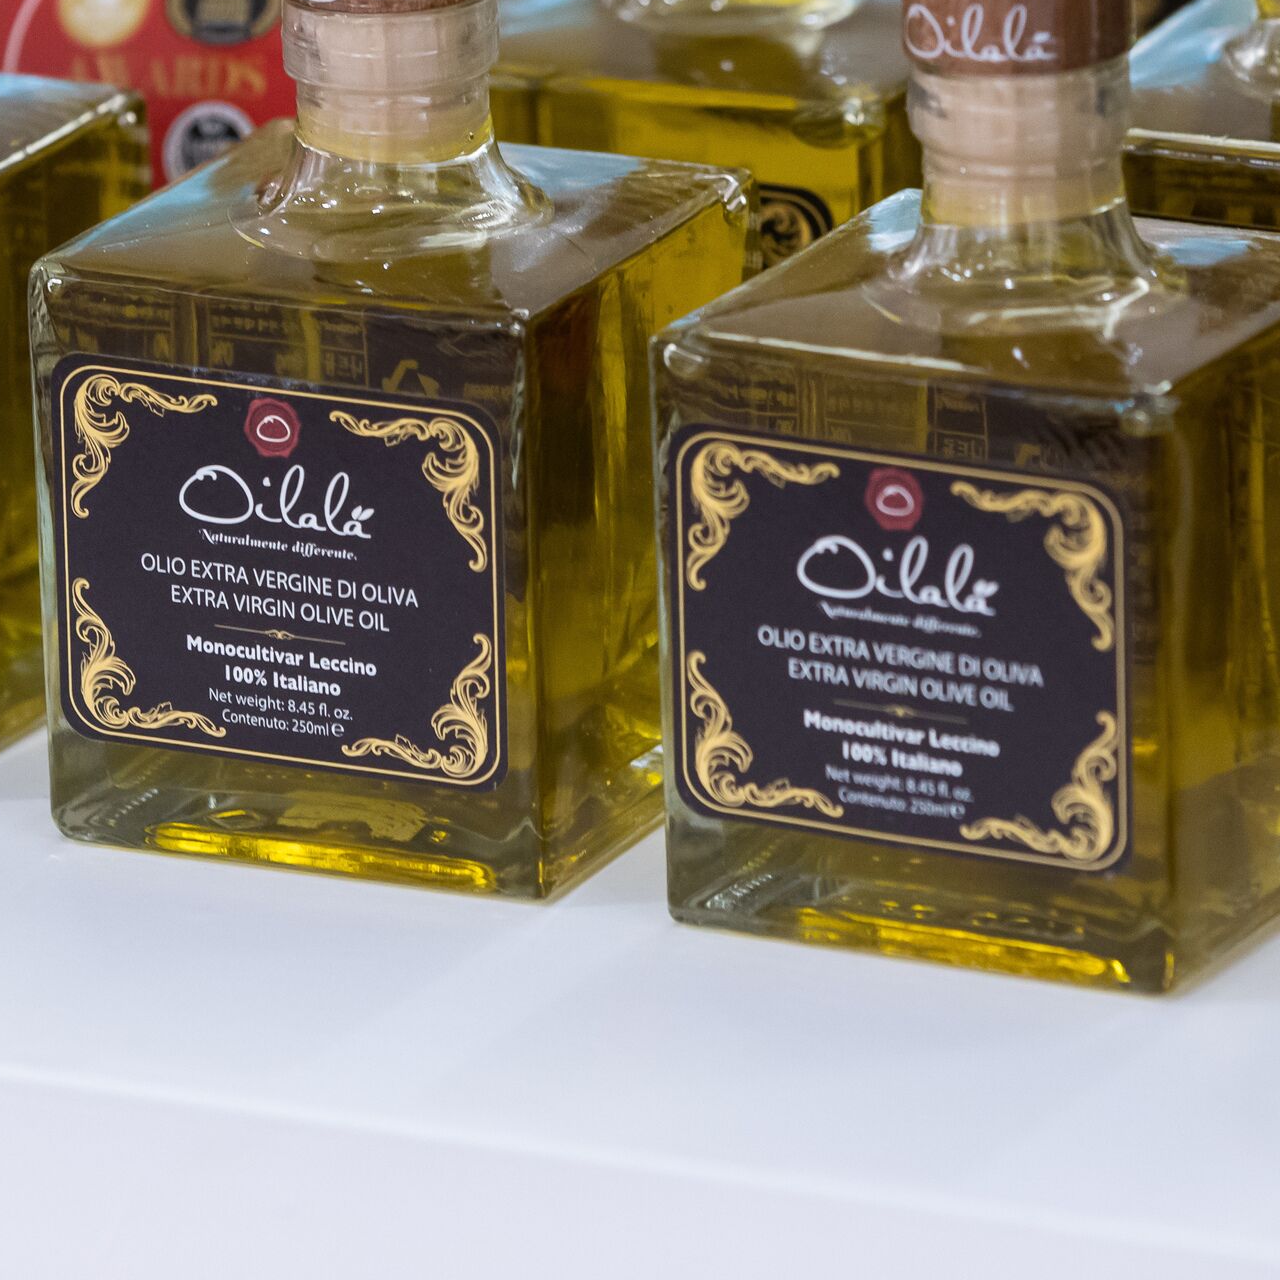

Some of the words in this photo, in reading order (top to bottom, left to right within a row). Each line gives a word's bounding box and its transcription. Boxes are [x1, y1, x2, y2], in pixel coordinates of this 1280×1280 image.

[198, 528, 289, 553] Naturalmente
[291, 540, 358, 561] differente.
[140, 552, 186, 576] OLIO
[190, 560, 249, 586] EXTRA
[253, 568, 332, 598] VERGINE
[338, 580, 357, 600] DI
[362, 583, 419, 608] OLIVA
[171, 585, 229, 610] EXTRA
[233, 593, 295, 619] VIRGIN
[300, 602, 354, 627] OLIVE
[359, 610, 390, 632] OIL
[186, 635, 304, 667] Monocultivar
[309, 650, 377, 677] Leccino
[757, 624, 804, 651] OLIO
[809, 632, 870, 660] EXTRA
[873, 641, 955, 676] VERGINE
[958, 654, 981, 677] DI
[983, 658, 1045, 687] OLIVA
[224, 665, 268, 686] 100%
[272, 671, 341, 697] Italiano
[788, 658, 849, 687] EXTRA
[852, 667, 918, 698] VIRGIN
[921, 677, 977, 707] OLIVE
[980, 686, 1014, 712] OIL
[208, 688, 230, 703] Net
[234, 691, 285, 713] weight:
[288, 698, 316, 716] 8.45
[336, 706, 353, 721] oz.
[221, 709, 289, 732] Contenuto:
[803, 709, 925, 746] Monocultivar
[929, 727, 1001, 758] Leccino
[842, 740, 888, 766] 100%
[891, 748, 964, 778] Italiano
